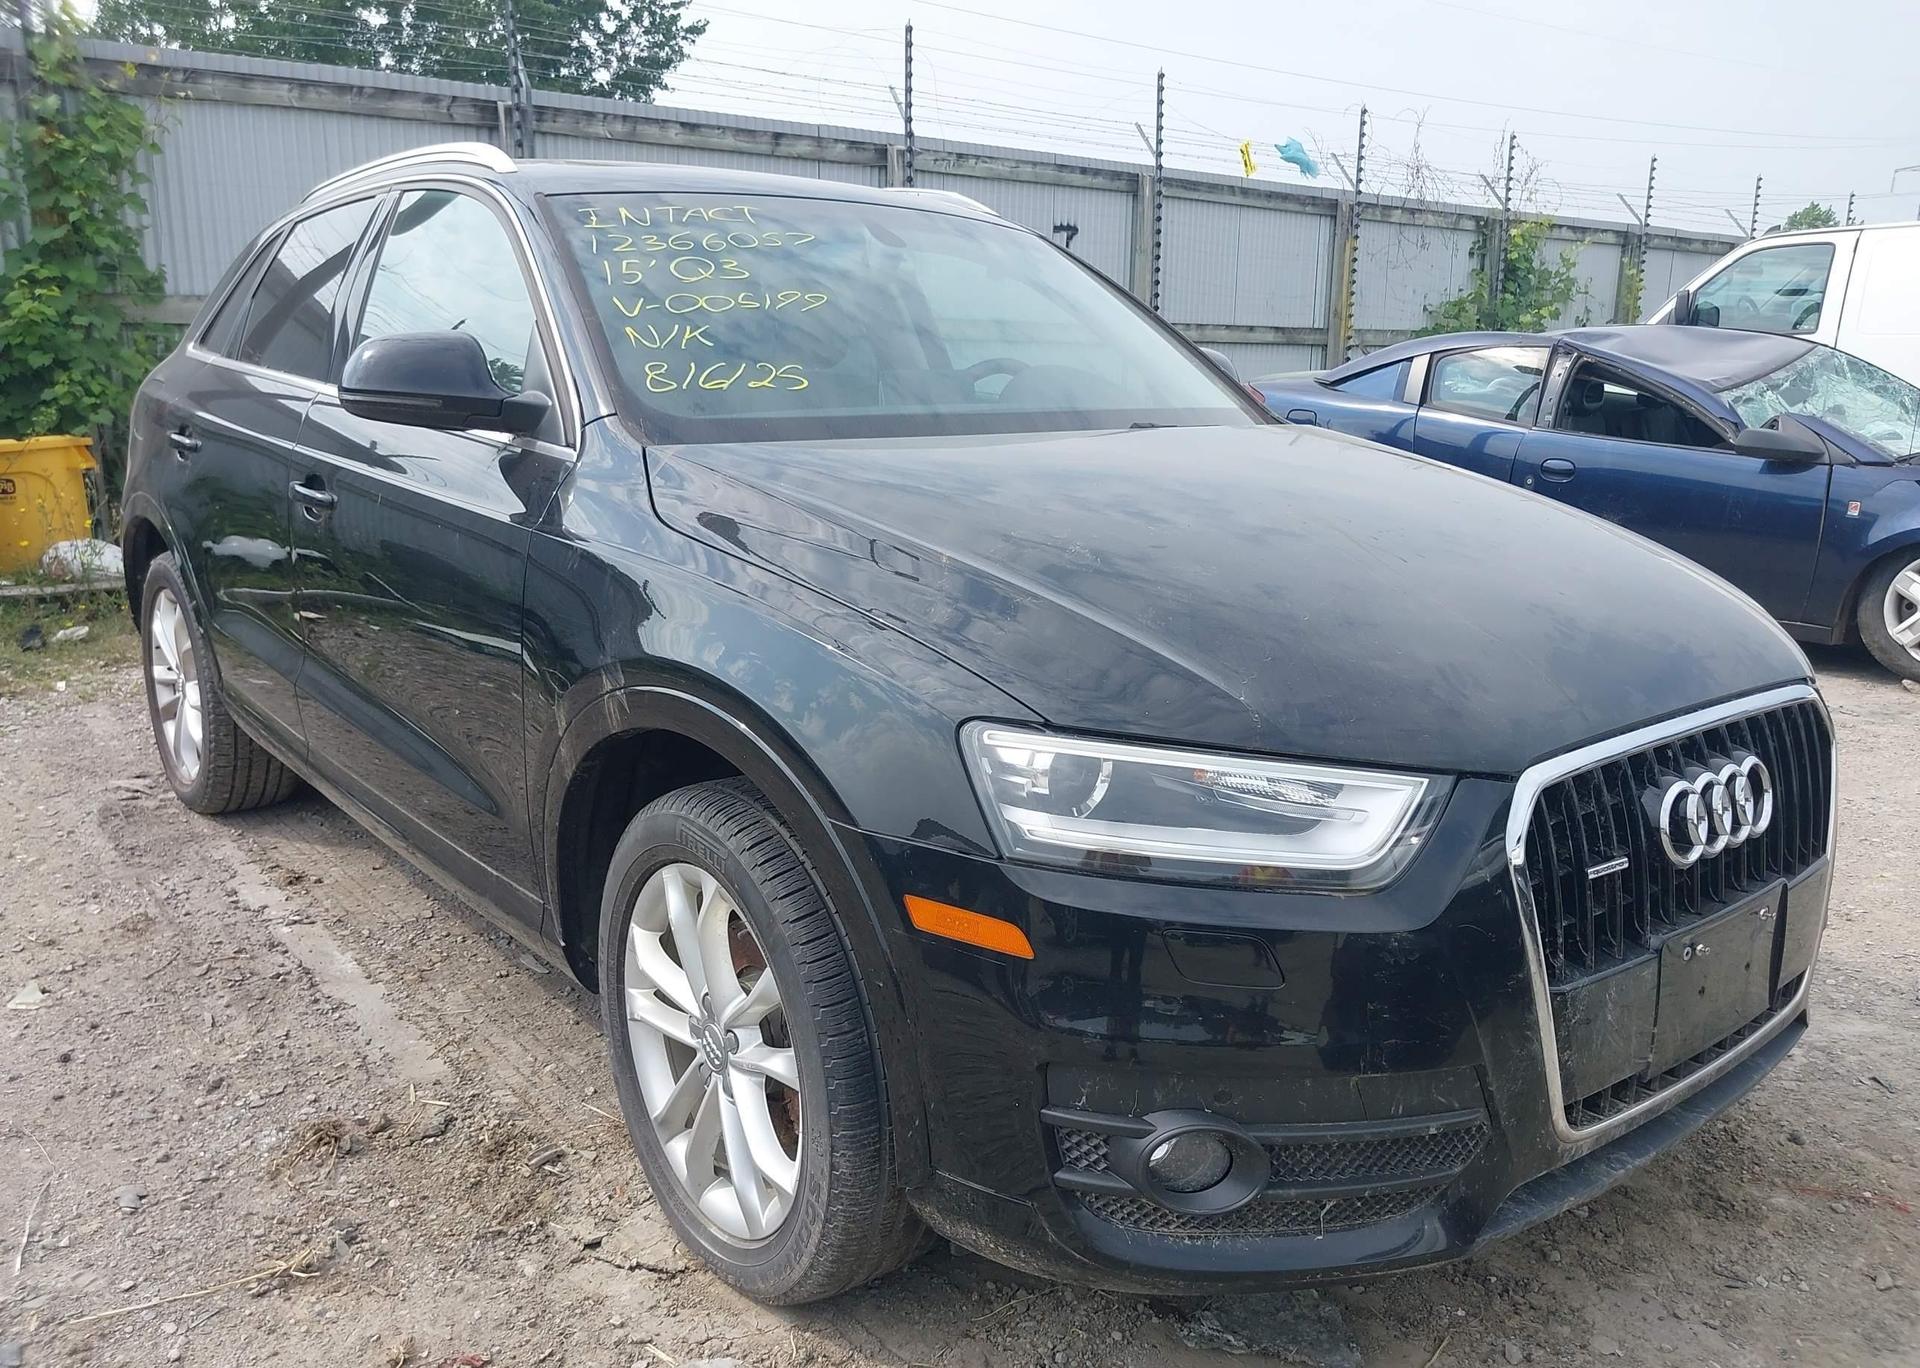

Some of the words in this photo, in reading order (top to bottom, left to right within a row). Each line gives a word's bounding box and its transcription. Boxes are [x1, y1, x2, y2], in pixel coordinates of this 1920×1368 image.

[578, 205, 760, 228] INTACT
[592, 231, 816, 254] 12366057
[669, 256, 750, 283] Q3
[612, 291, 828, 317] V-005199
[624, 324, 714, 349] N/K
[644, 362, 809, 392] 8/6/25
[676, 819, 728, 875] PIRELLI
[1591, 860, 1626, 877] quattro
